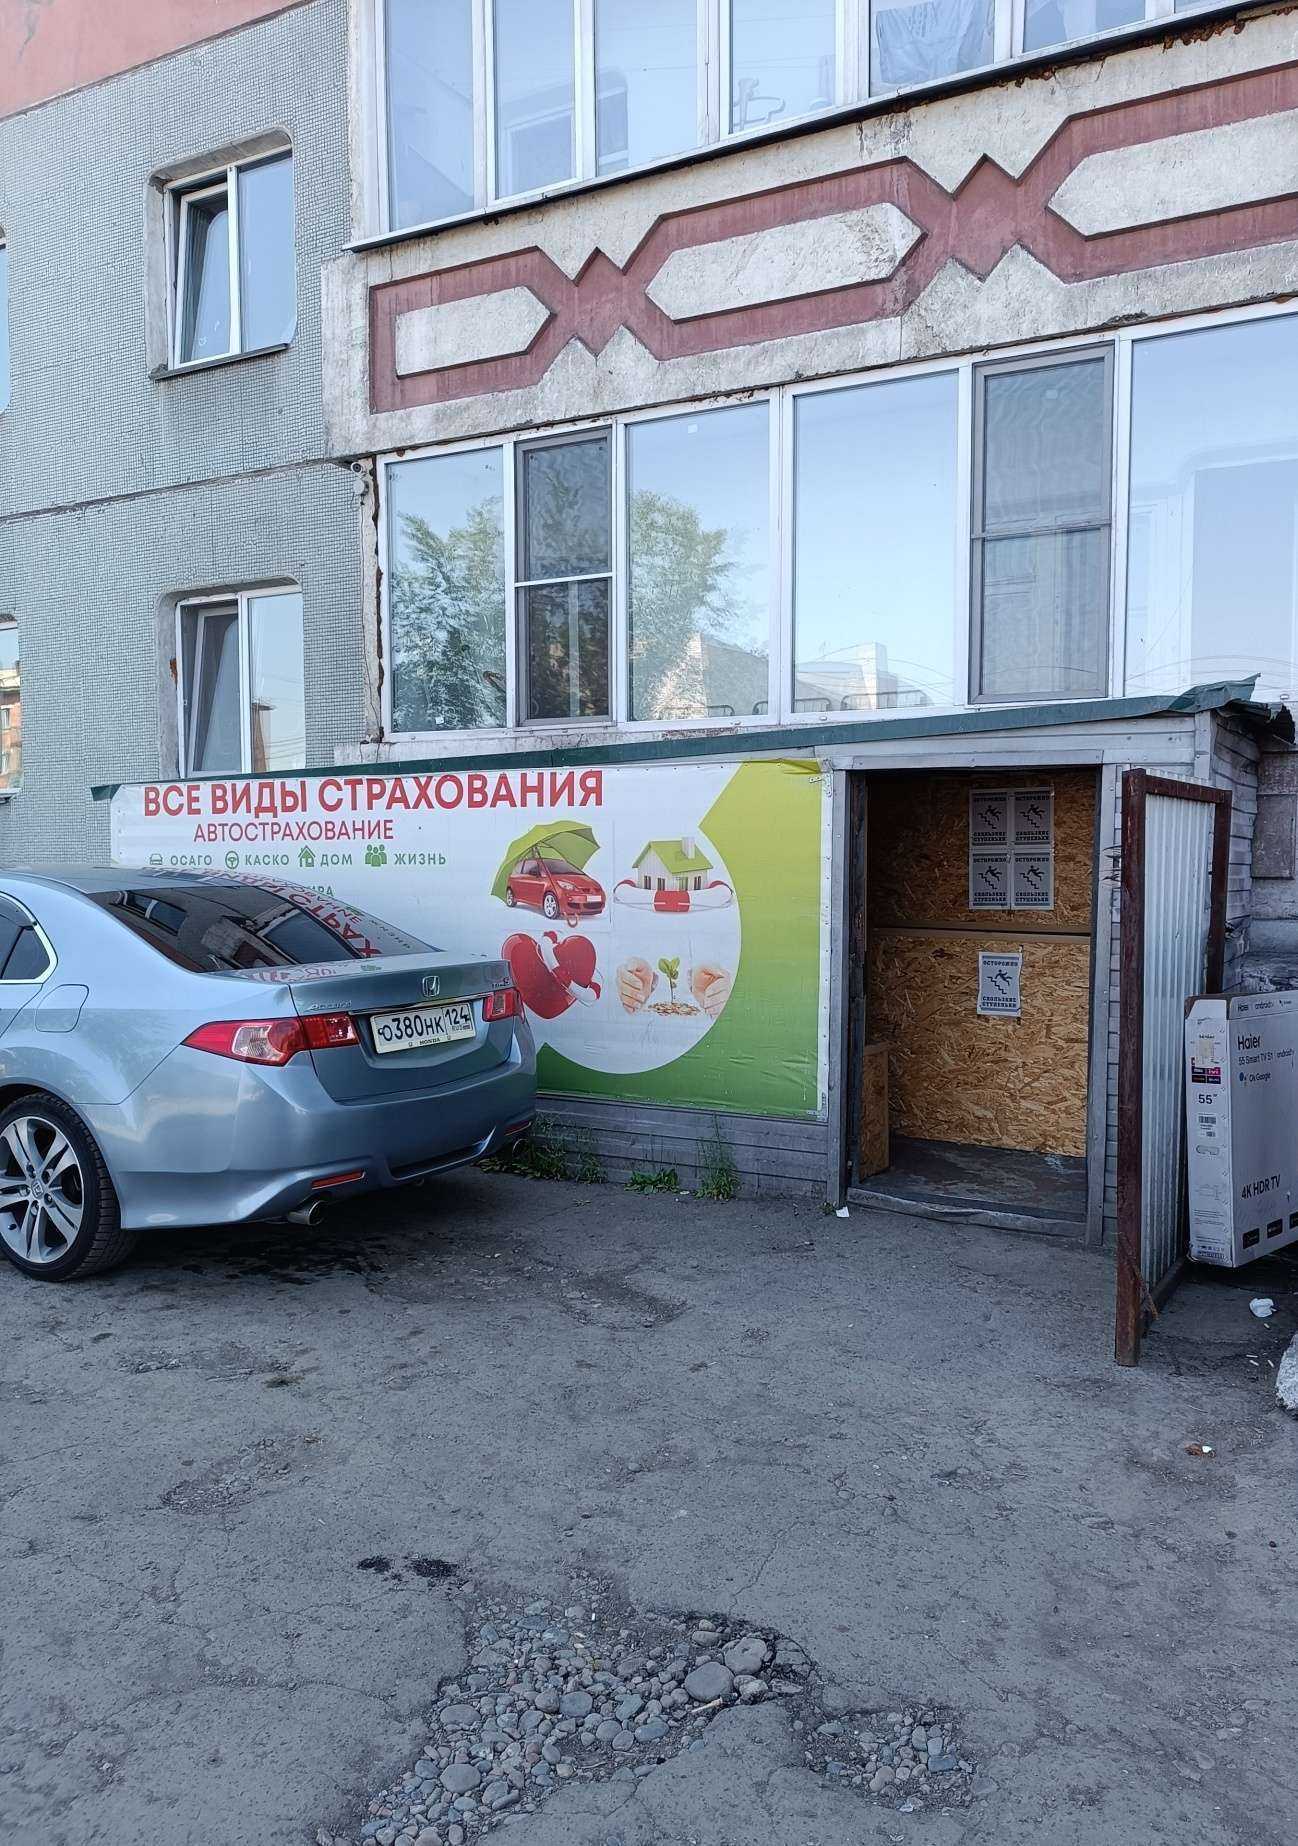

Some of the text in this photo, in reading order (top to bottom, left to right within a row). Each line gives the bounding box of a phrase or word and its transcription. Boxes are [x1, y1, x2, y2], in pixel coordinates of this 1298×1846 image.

[144, 770, 603, 819] ВСЕ ВИДЫ СТРАХОВАНИЯ
[194, 819, 394, 842] АВТОСТРАХОВАНИЕ
[170, 853, 446, 867] ОСАГО КАСКО ДОМ ЖИЗНЬ
[1237, 1034, 1261, 1051] Haier
[1241, 1174, 1281, 1199] 4K HDR TV
